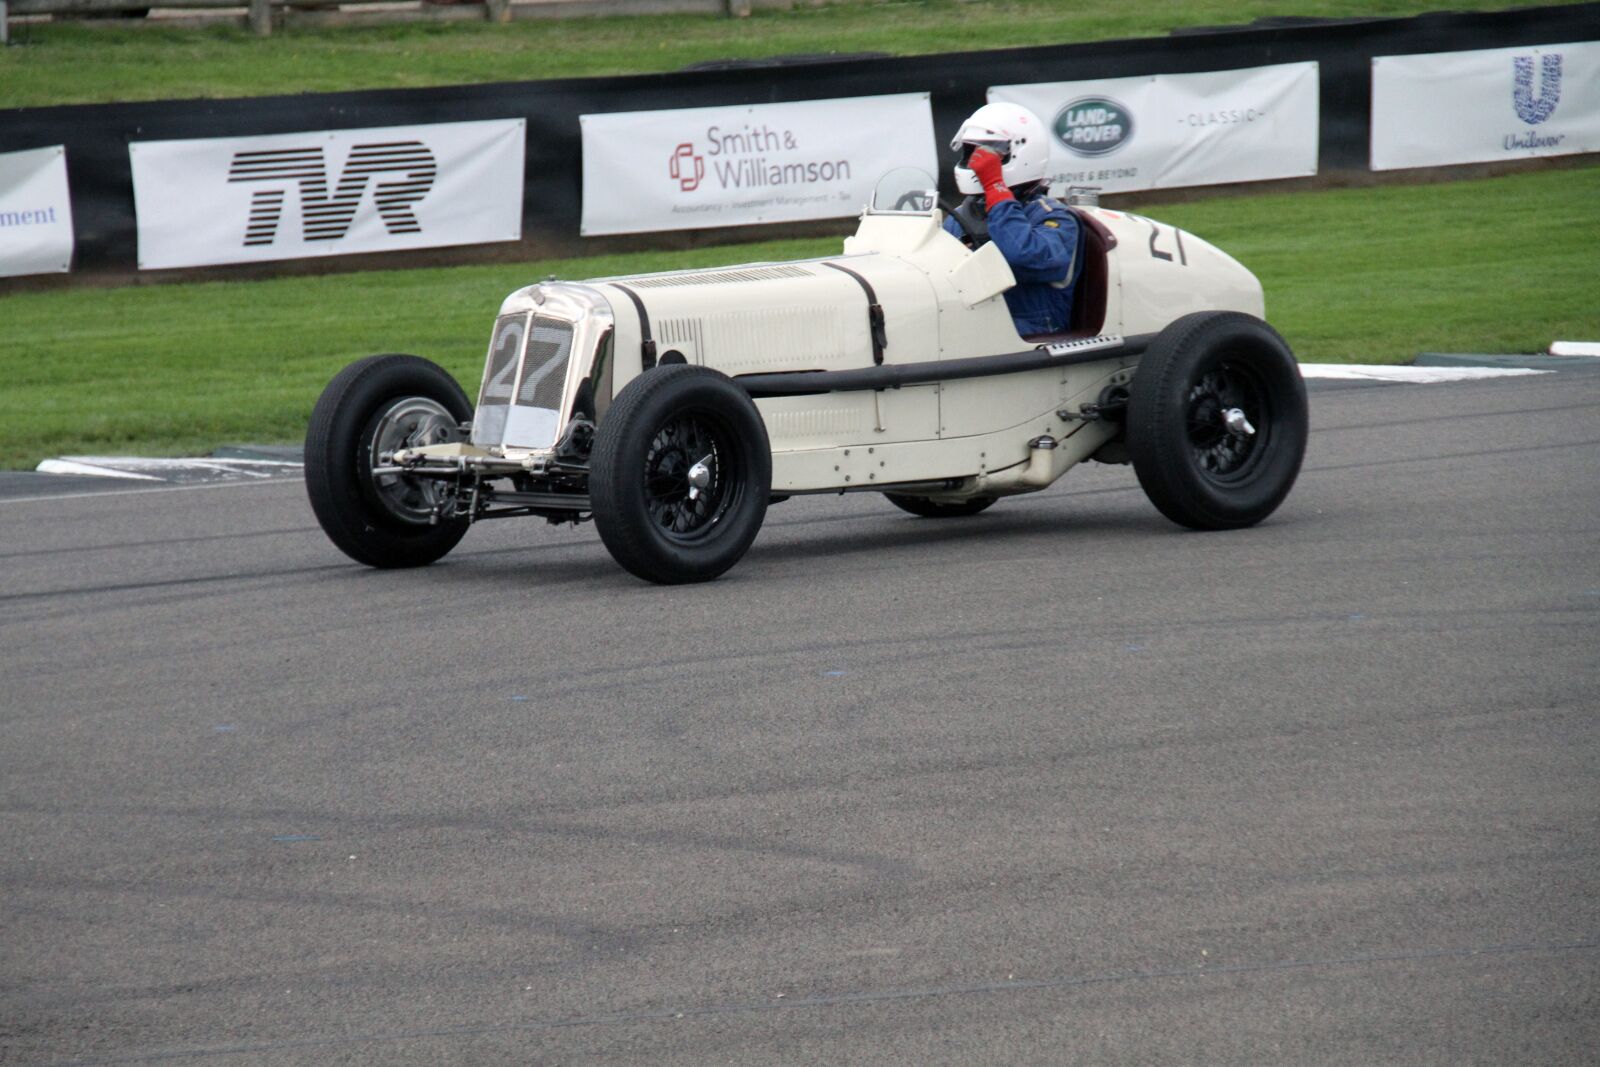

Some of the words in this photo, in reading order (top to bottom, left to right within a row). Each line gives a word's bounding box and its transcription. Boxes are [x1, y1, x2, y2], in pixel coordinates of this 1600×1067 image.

[1066, 108, 1106, 126] LAND
[707, 125, 779, 156] Smith
[784, 130, 799, 150] &
[1071, 125, 1122, 143] ROVER
[714, 159, 852, 189] Williamson
[1099, 167, 1138, 180] BEYOND
[227, 141, 437, 246] TVR
[485, 322, 574, 400] 27
